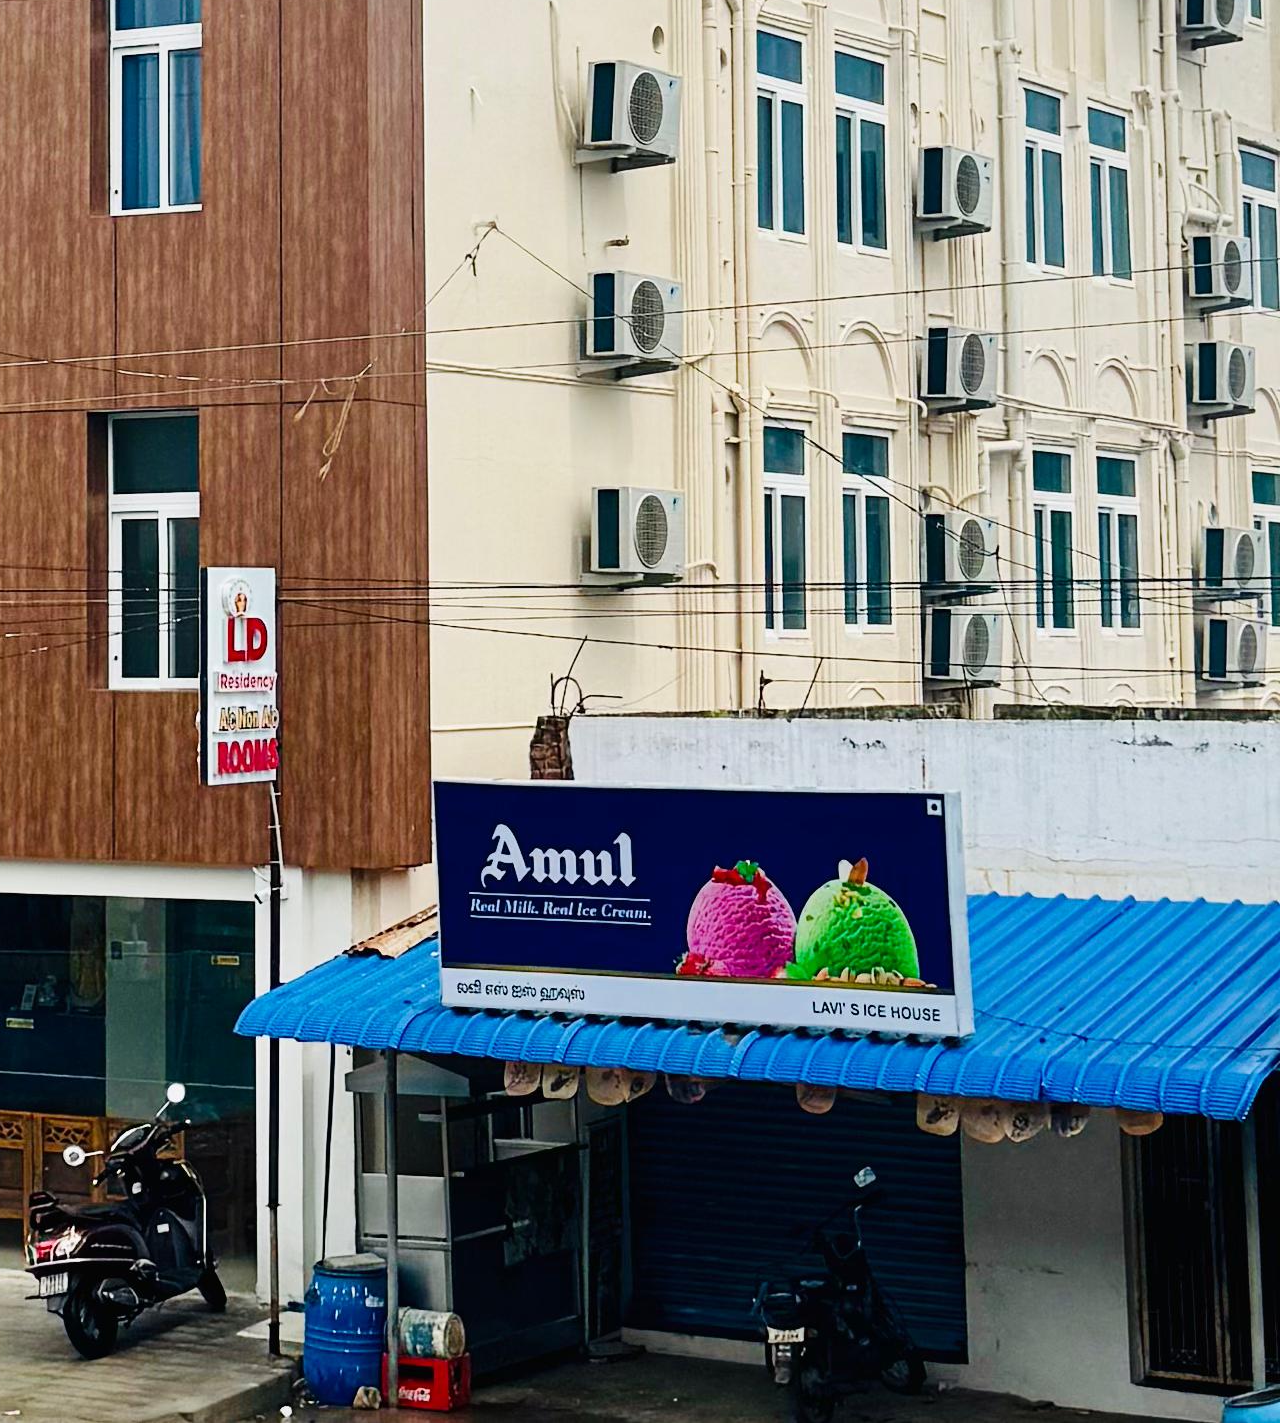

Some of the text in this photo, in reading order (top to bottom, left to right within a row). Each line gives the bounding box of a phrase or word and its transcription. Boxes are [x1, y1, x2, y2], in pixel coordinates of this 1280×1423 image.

[227, 617, 268, 662] LD
[220, 672, 276, 691] Residency
[217, 738, 280, 775] ROOMS
[480, 823, 637, 888] Amul
[470, 898, 652, 920] Real Milk. Real Ice Cream.
[863, 1004, 886, 1018] ICE
[890, 1006, 941, 1022] HOUSE
